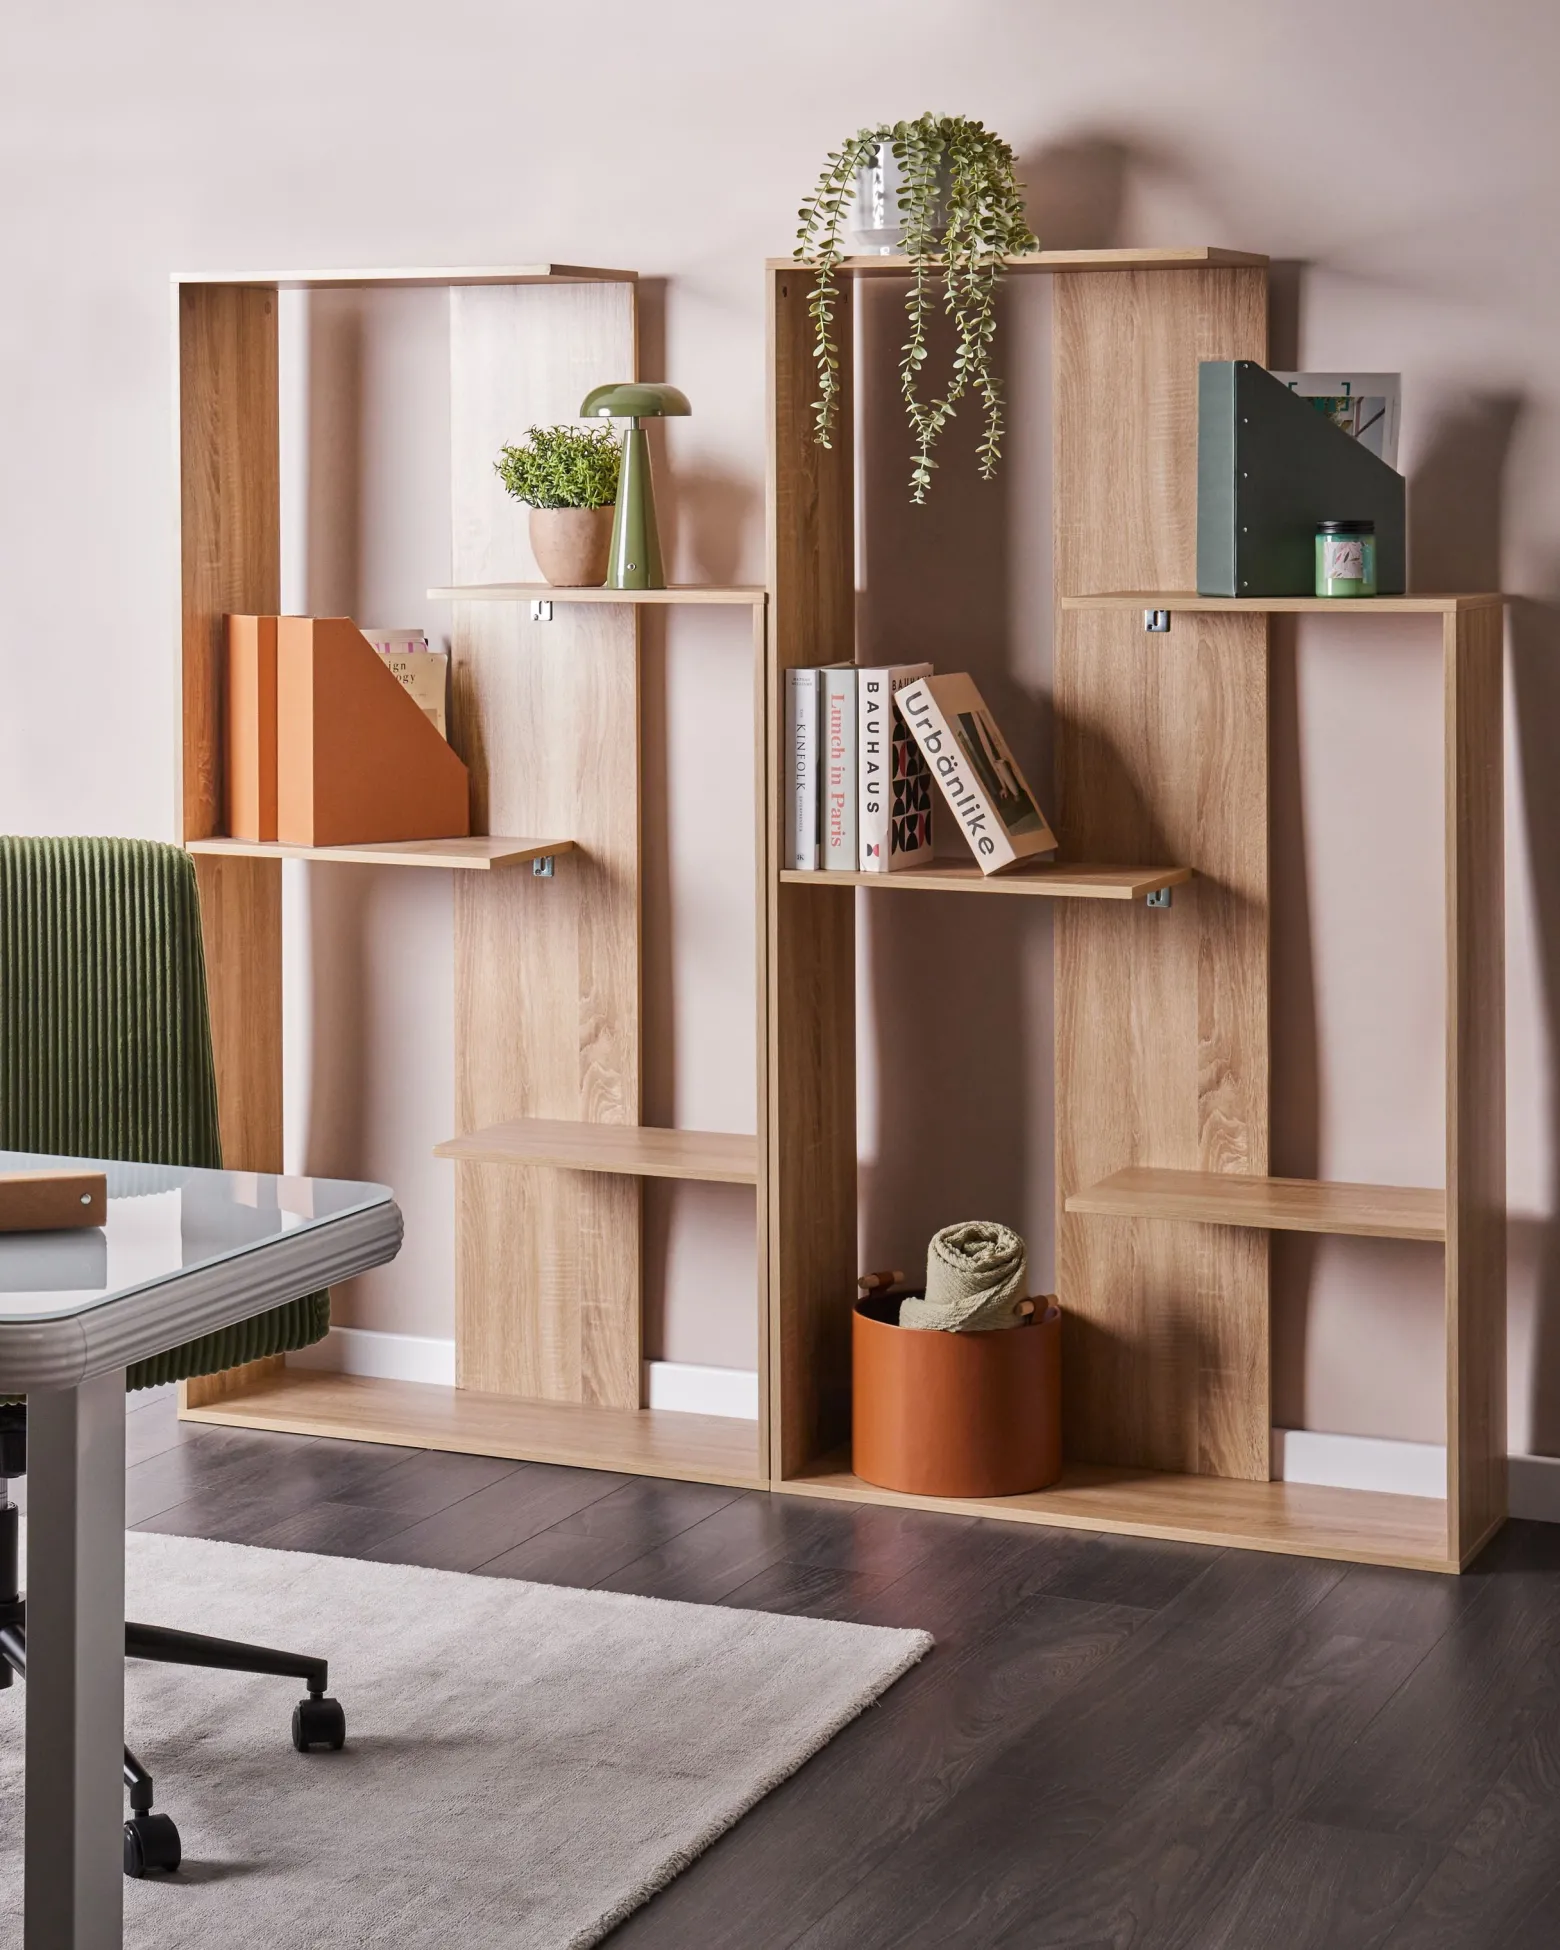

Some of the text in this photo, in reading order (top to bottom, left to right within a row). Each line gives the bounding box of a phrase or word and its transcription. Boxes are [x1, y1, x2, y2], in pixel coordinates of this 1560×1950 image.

[867, 682, 880, 813] BAUHAUS
[891, 674, 932, 691] BAUH
[796, 723, 806, 790] KINFOLK
[831, 694, 846, 848] Lunch in Paris
[905, 691, 996, 856] Urbänlike
